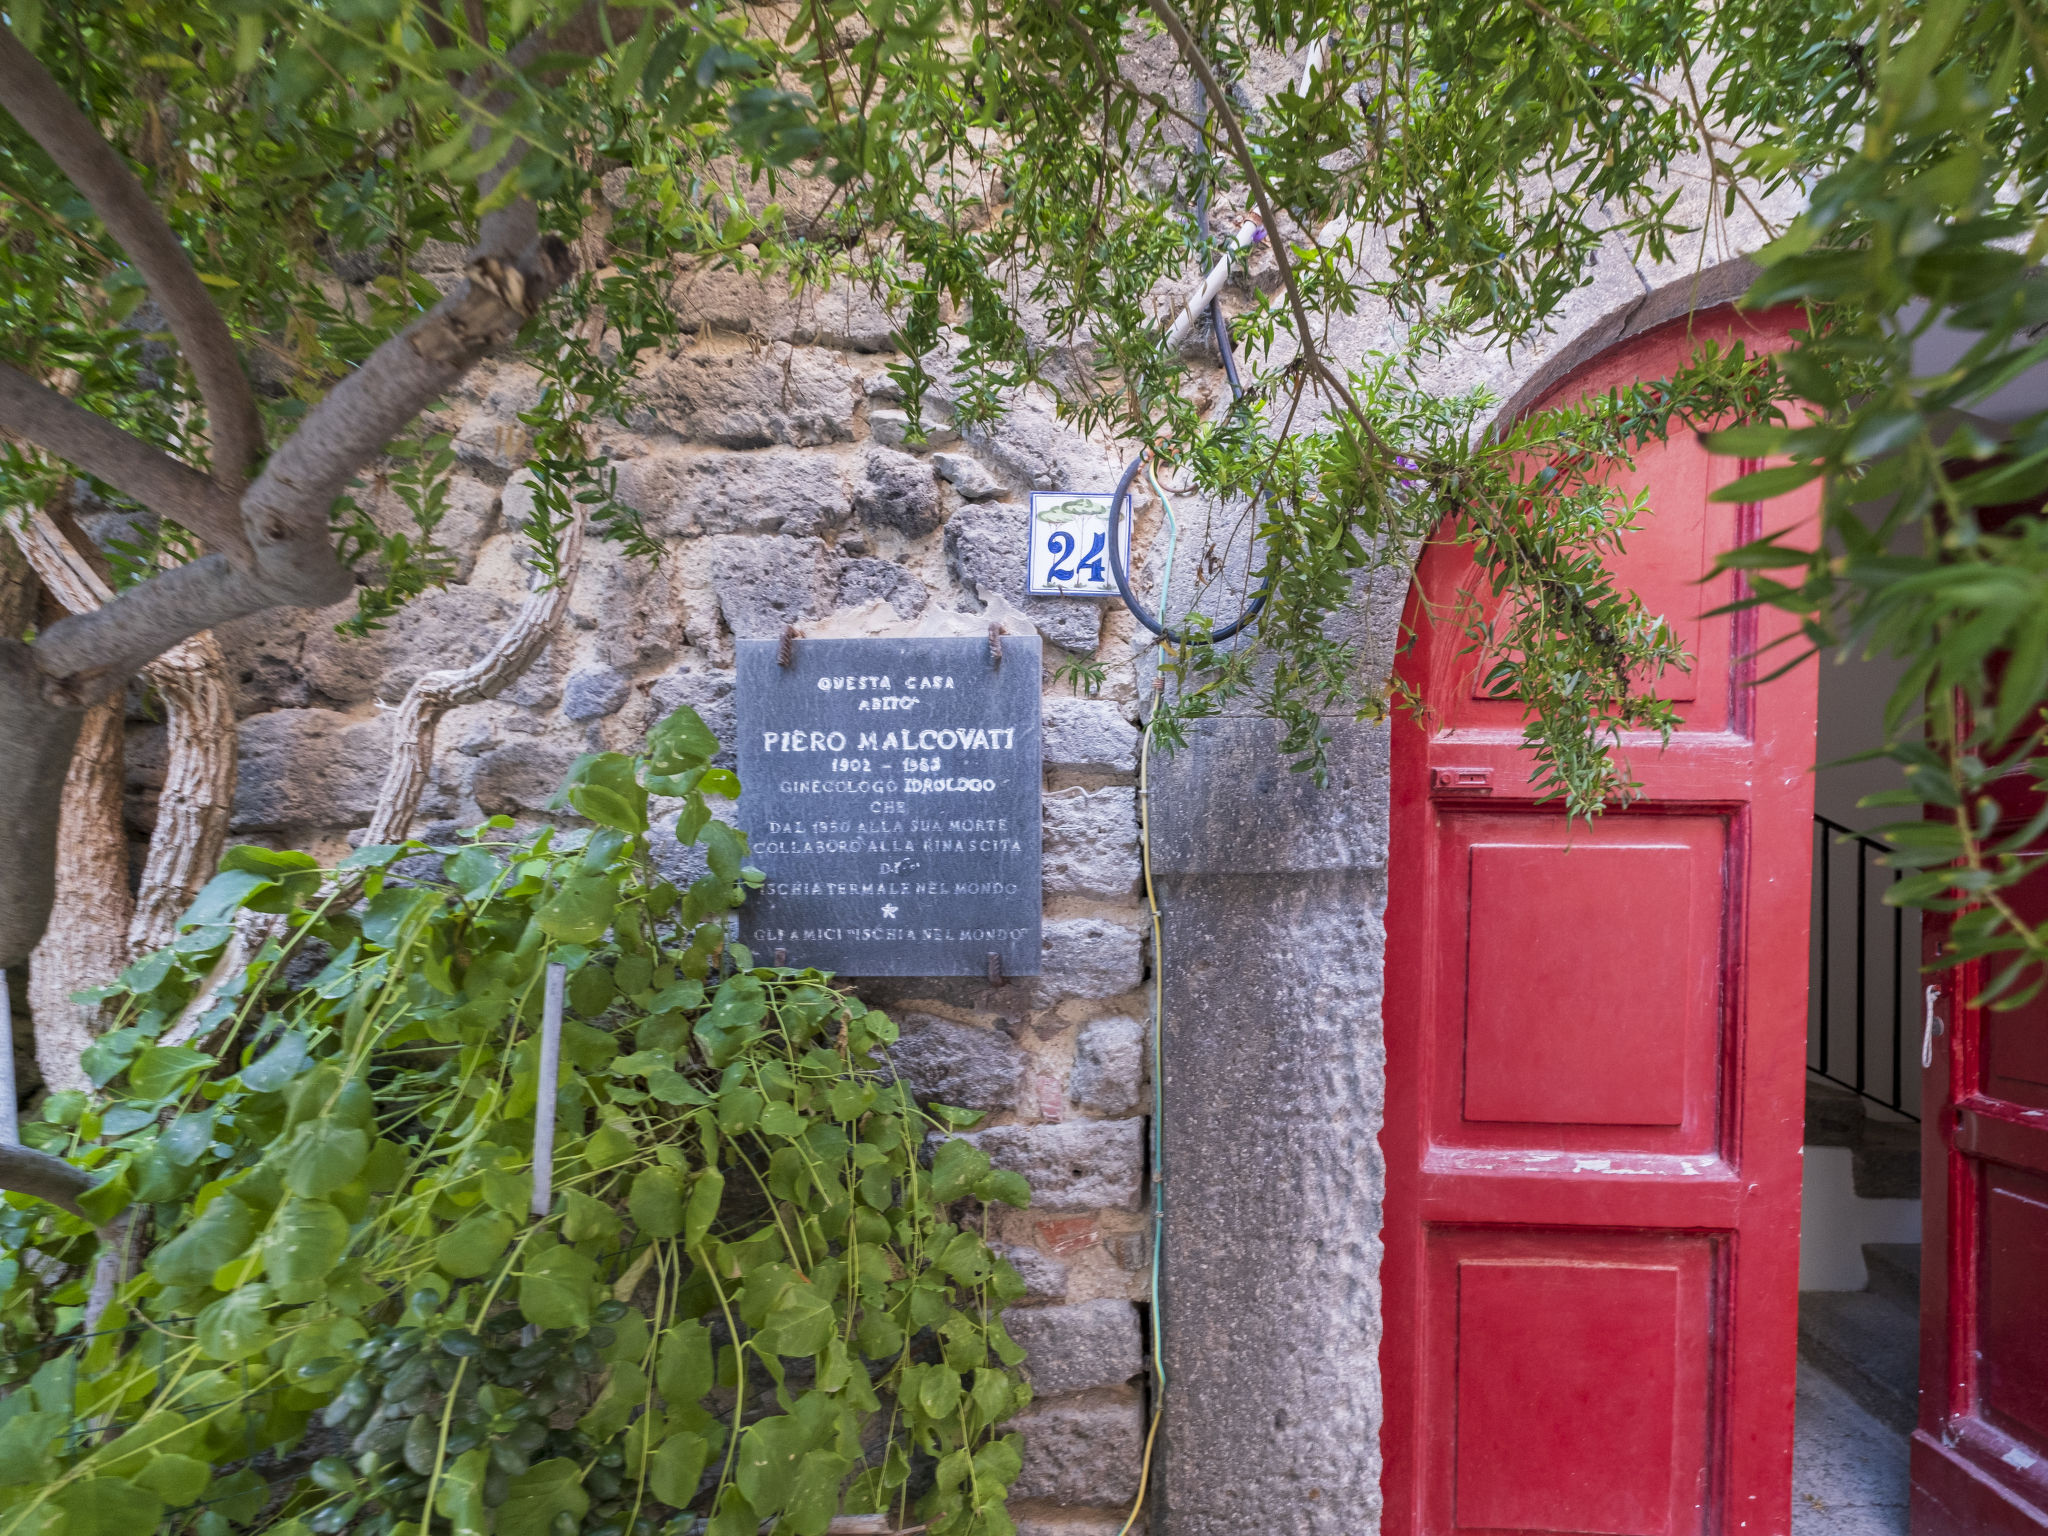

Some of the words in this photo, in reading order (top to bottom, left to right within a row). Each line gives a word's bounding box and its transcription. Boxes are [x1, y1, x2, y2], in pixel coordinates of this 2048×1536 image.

[1046, 531, 1105, 582] 24
[817, 676, 891, 690] QUESTA
[905, 676, 954, 689] CASA
[763, 730, 846, 752] PIERO
[857, 727, 1015, 750] MALCOVATI
[832, 758, 871, 772] 1902
[780, 781, 898, 794] GINECOLOGO
[904, 778, 996, 794] IDROLOGO
[870, 801, 905, 814] CHE
[769, 821, 806, 834] DAL
[812, 820, 850, 834] 1950
[857, 820, 902, 833] ALLA
[910, 819, 942, 832] SUA
[949, 818, 1008, 831] MORTE
[867, 840, 914, 852] ALLA
[924, 839, 1021, 852] RINASCITA
[826, 882, 910, 895] TERMALE
[915, 881, 949, 895] NEL
[953, 882, 1017, 895] MONDO
[789, 928, 842, 941] AMICI
[922, 928, 955, 941] NEL
